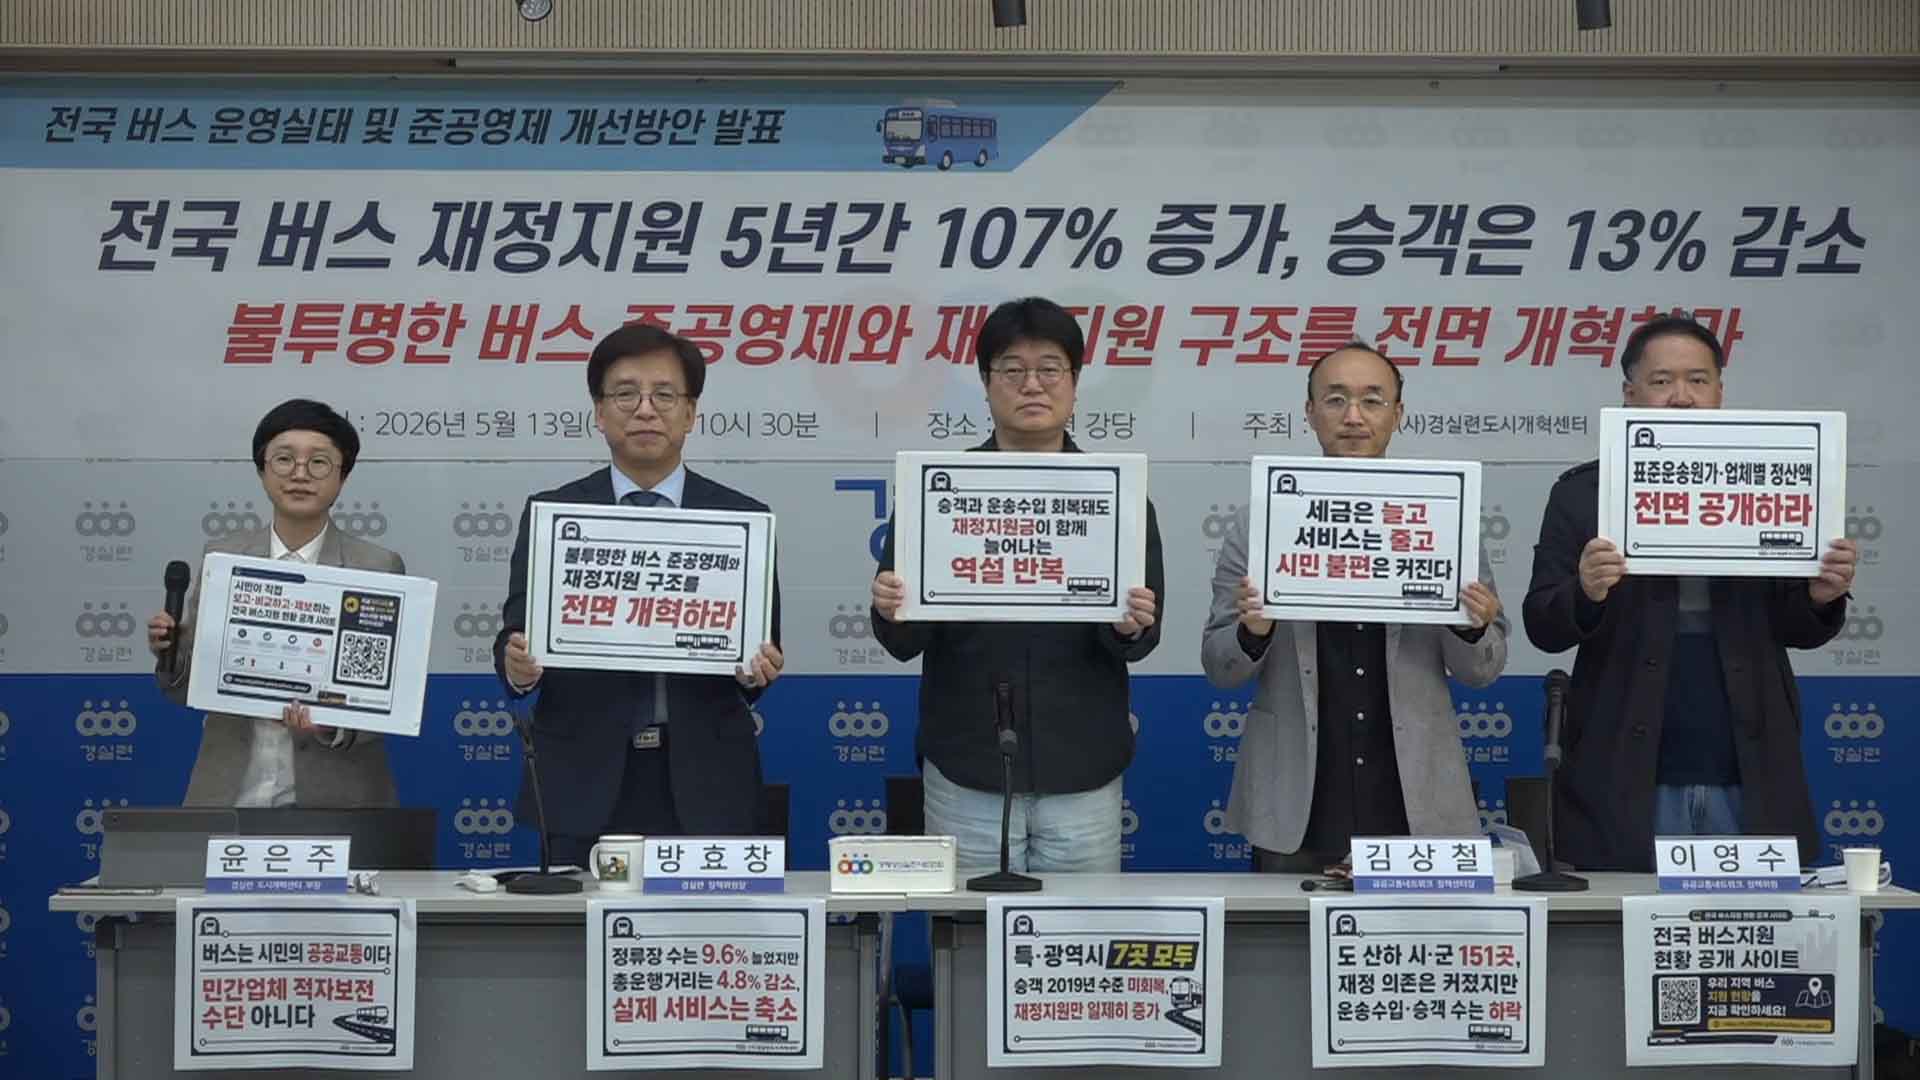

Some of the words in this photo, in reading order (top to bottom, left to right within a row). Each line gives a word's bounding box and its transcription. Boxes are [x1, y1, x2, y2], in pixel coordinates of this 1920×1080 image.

[45, 107, 117, 144] 전국
[127, 107, 197, 144] 버스
[208, 107, 350, 145] 운영실태
[362, 107, 399, 145] 및
[407, 107, 551, 146] 준공영제
[559, 107, 707, 146] 개선방안
[712, 108, 785, 146] 발표
[98, 200, 240, 272] 전국
[258, 200, 397, 271] 버스
[417, 200, 701, 274] 재정지원
[719, 201, 911, 274] 5년간
[936, 206, 1124, 270] 107%
[1147, 202, 1298, 280] 증가,
[1326, 203, 1537, 276] 승객은
[1565, 209, 1707, 273] 13%
[1729, 206, 1868, 278] 감소
[223, 301, 467, 365] 불투명한
[478, 303, 595, 364] 버스
[925, 304, 1165, 366] 재지원
[1179, 306, 1358, 366] 구조를
[1375, 306, 1492, 366] 전면
[375, 410, 466, 438] 2026년
[475, 410, 516, 438] 5월
[528, 410, 598, 438] 13일(
[697, 411, 752, 438] 10시
[760, 412, 820, 439] 30분
[927, 411, 978, 439] 장소
[1086, 411, 1137, 440] 강당
[1242, 412, 1292, 440] 주최
[1770, 463, 1812, 486] 정산액
[937, 497, 982, 514] 승객과
[987, 497, 1047, 515] 운송수입
[1051, 498, 1110, 515] 회복돼도
[1306, 499, 1374, 524] 세금은
[1381, 501, 1428, 525] 늘고
[1634, 491, 1689, 525] 전면
[1699, 492, 1813, 527] 공개하라
[952, 518, 1051, 536] 재정지원금이
[1056, 519, 1087, 537] 함께
[1294, 526, 1382, 551] 서비스는
[1390, 528, 1435, 552] 줄고
[564, 546, 627, 567] 불투명한
[631, 550, 661, 569] 버스
[666, 551, 740, 571] 준공영제와
[984, 538, 1052, 556] 늘어나는
[951, 557, 1005, 585] 역설
[1012, 557, 1064, 585] 반복
[1275, 553, 1320, 577] 시민
[1326, 555, 1390, 579] 불편은
[1396, 558, 1453, 580] 커진다
[563, 569, 641, 591] 재정지원
[645, 573, 700, 593] 구조를
[561, 594, 617, 626] 전면
[625, 597, 738, 630] 개혁하라
[80, 744, 134, 761] 경실련
[458, 744, 511, 761] 경실련
[832, 745, 886, 762] 경실련
[1827, 746, 1881, 764] 경실련
[1653, 925, 1692, 946] 전국
[1698, 925, 1775, 946] 버스지원
[202, 942, 253, 964] 버스는
[258, 942, 303, 964] 시민의
[307, 943, 392, 965] 공공교통이다
[612, 946, 663, 966] 정류장
[666, 947, 698, 965] 수는
[702, 944, 749, 965] 9.6%
[751, 951, 799, 965] 늘었지만
[1112, 943, 1149, 967] 7곳
[1152, 943, 1194, 968] 모두
[1337, 945, 1356, 966] 도
[1363, 944, 1402, 967] 산하
[1458, 945, 1521, 969] 151곳,
[1654, 950, 1692, 970] 현황
[1698, 949, 1735, 969] 공개
[1740, 949, 1799, 969] 사이트
[202, 978, 288, 1001] 민간업체
[293, 977, 375, 1003] 적자보전
[612, 971, 713, 992] 총운행거리는
[716, 970, 761, 990] 4.8%
[1014, 977, 1043, 994] 승객
[1047, 977, 1096, 994] 2019년
[1099, 977, 1125, 994] 수준
[1338, 973, 1376, 995] 재정
[1382, 973, 1436, 993] 의존은
[1443, 973, 1519, 995] 커졌지만
[1707, 976, 1728, 989] 우리
[1730, 976, 1751, 989] 지역
[1754, 977, 1776, 989] 버스
[202, 1004, 246, 1030] 수단
[251, 1004, 316, 1028] 아니다
[612, 996, 657, 1023] 실제
[663, 995, 750, 1022] 서비스는
[754, 996, 798, 1023] 축소
[1014, 1001, 1084, 1021] 재정지원만
[1087, 1001, 1128, 1021] 일제히
[1132, 1002, 1161, 1021] 증가
[1450, 1001, 1485, 1021] 수는
[1488, 1001, 1522, 1021] 하락
[1707, 1005, 1728, 1016] 지금
